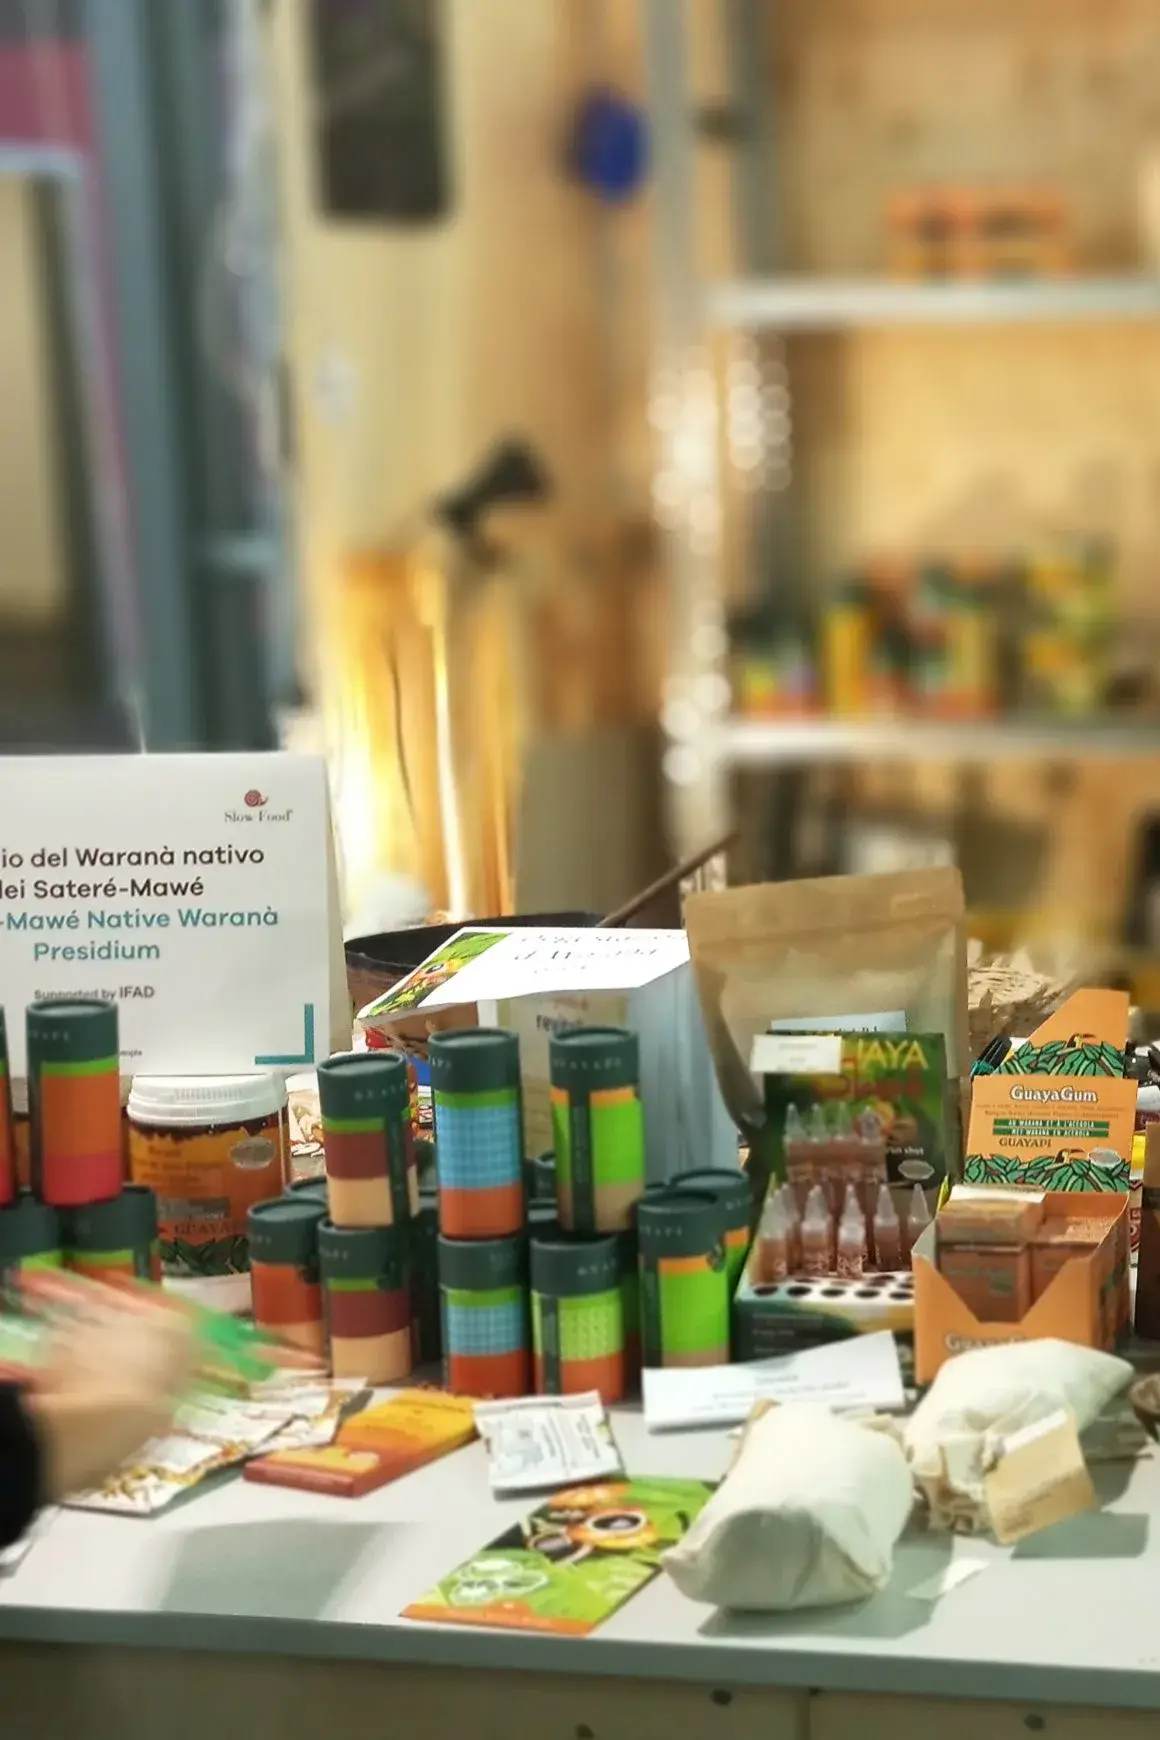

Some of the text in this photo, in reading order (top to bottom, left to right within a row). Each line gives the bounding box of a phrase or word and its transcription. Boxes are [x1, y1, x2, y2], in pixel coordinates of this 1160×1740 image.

[225, 809, 290, 823] Slow Food
[30, 847, 67, 868] del
[75, 845, 175, 867] Waranà
[183, 844, 264, 865] nativo
[0, 876, 204, 899] ei Sateré-Mawé
[88, 908, 170, 928] Native
[178, 906, 278, 927] Waranà
[34, 940, 160, 961] Presidium
[102, 987, 117, 999] by
[119, 985, 155, 998] IFAD
[1009, 1084, 1099, 1103] GuayaGum
